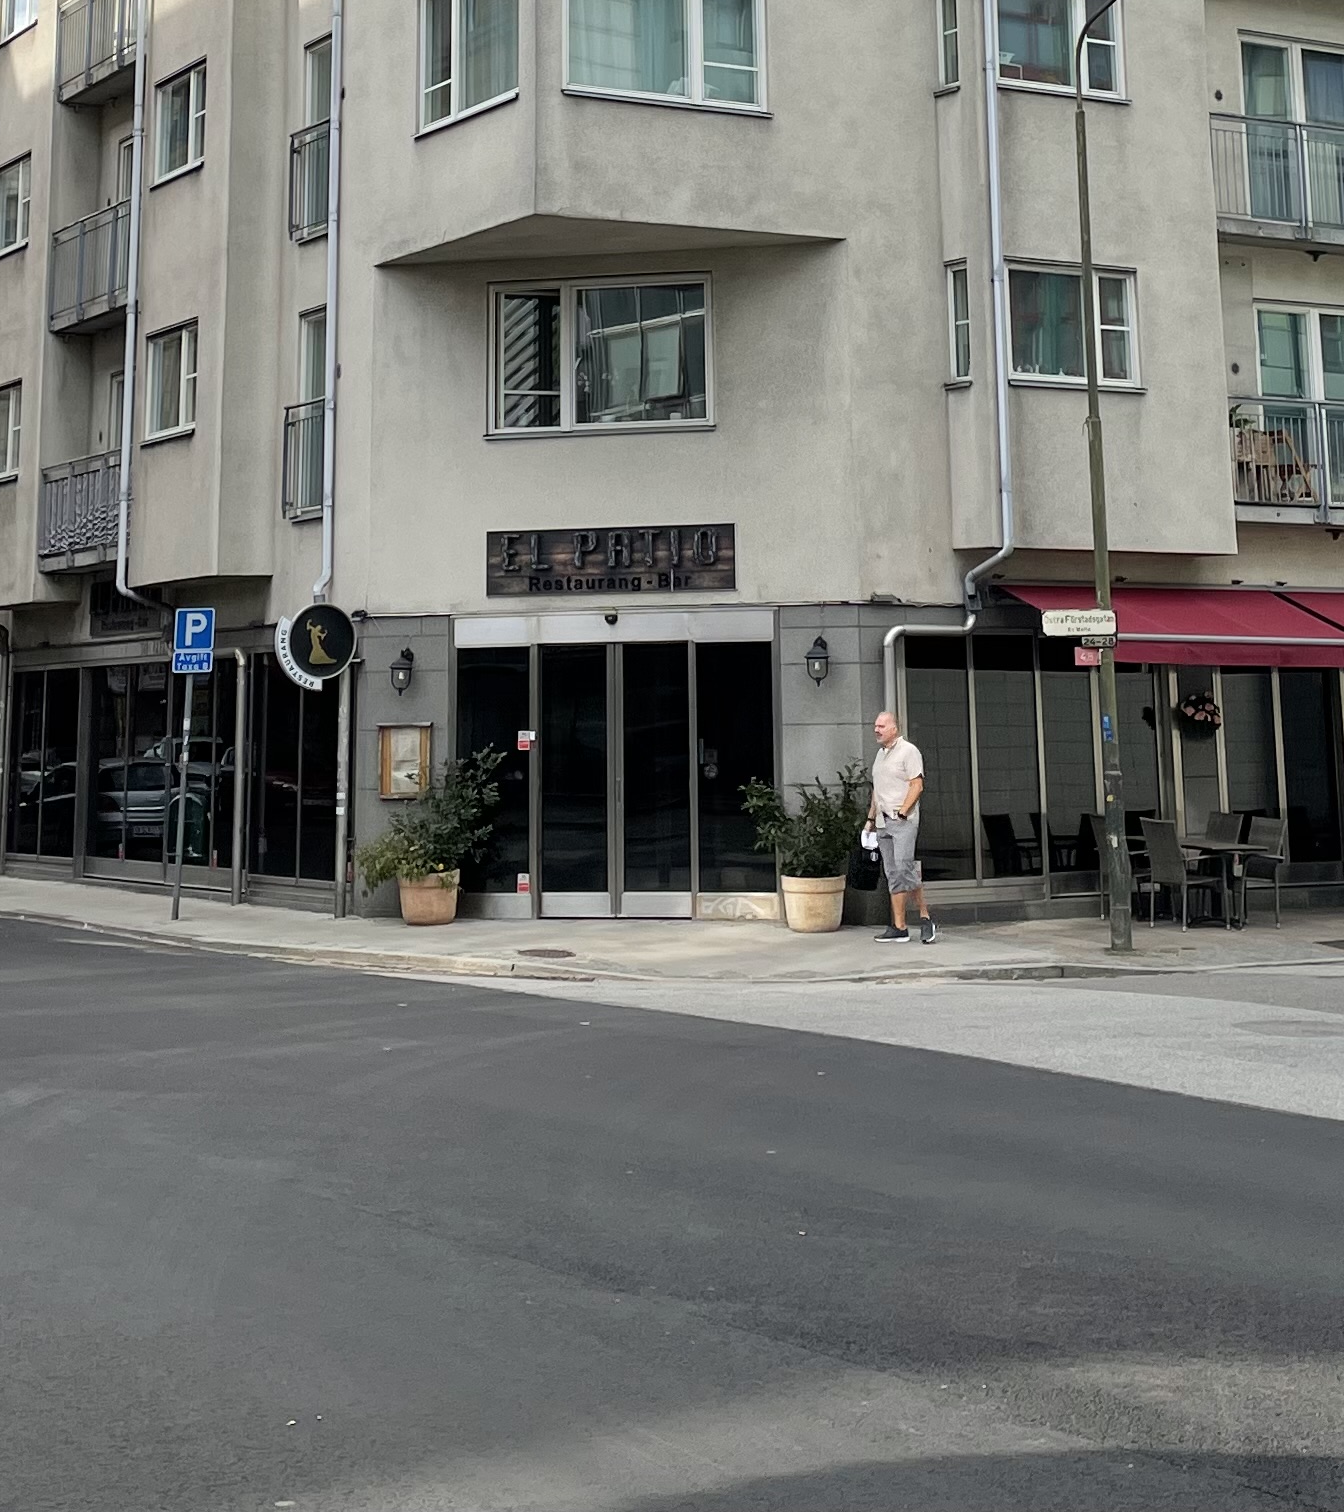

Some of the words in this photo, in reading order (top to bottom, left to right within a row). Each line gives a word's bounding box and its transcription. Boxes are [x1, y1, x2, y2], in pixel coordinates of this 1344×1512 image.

[501, 533, 552, 572] EL
[573, 527, 719, 569] PATIO
[528, 574, 642, 592] Restaurang
[658, 572, 692, 590] Bar
[184, 612, 208, 647] P
[1083, 637, 1115, 646] 24-28
[176, 663, 200, 671] Taxa
[178, 653, 208, 663] Avgift
[280, 628, 315, 688] RESTAURANG
